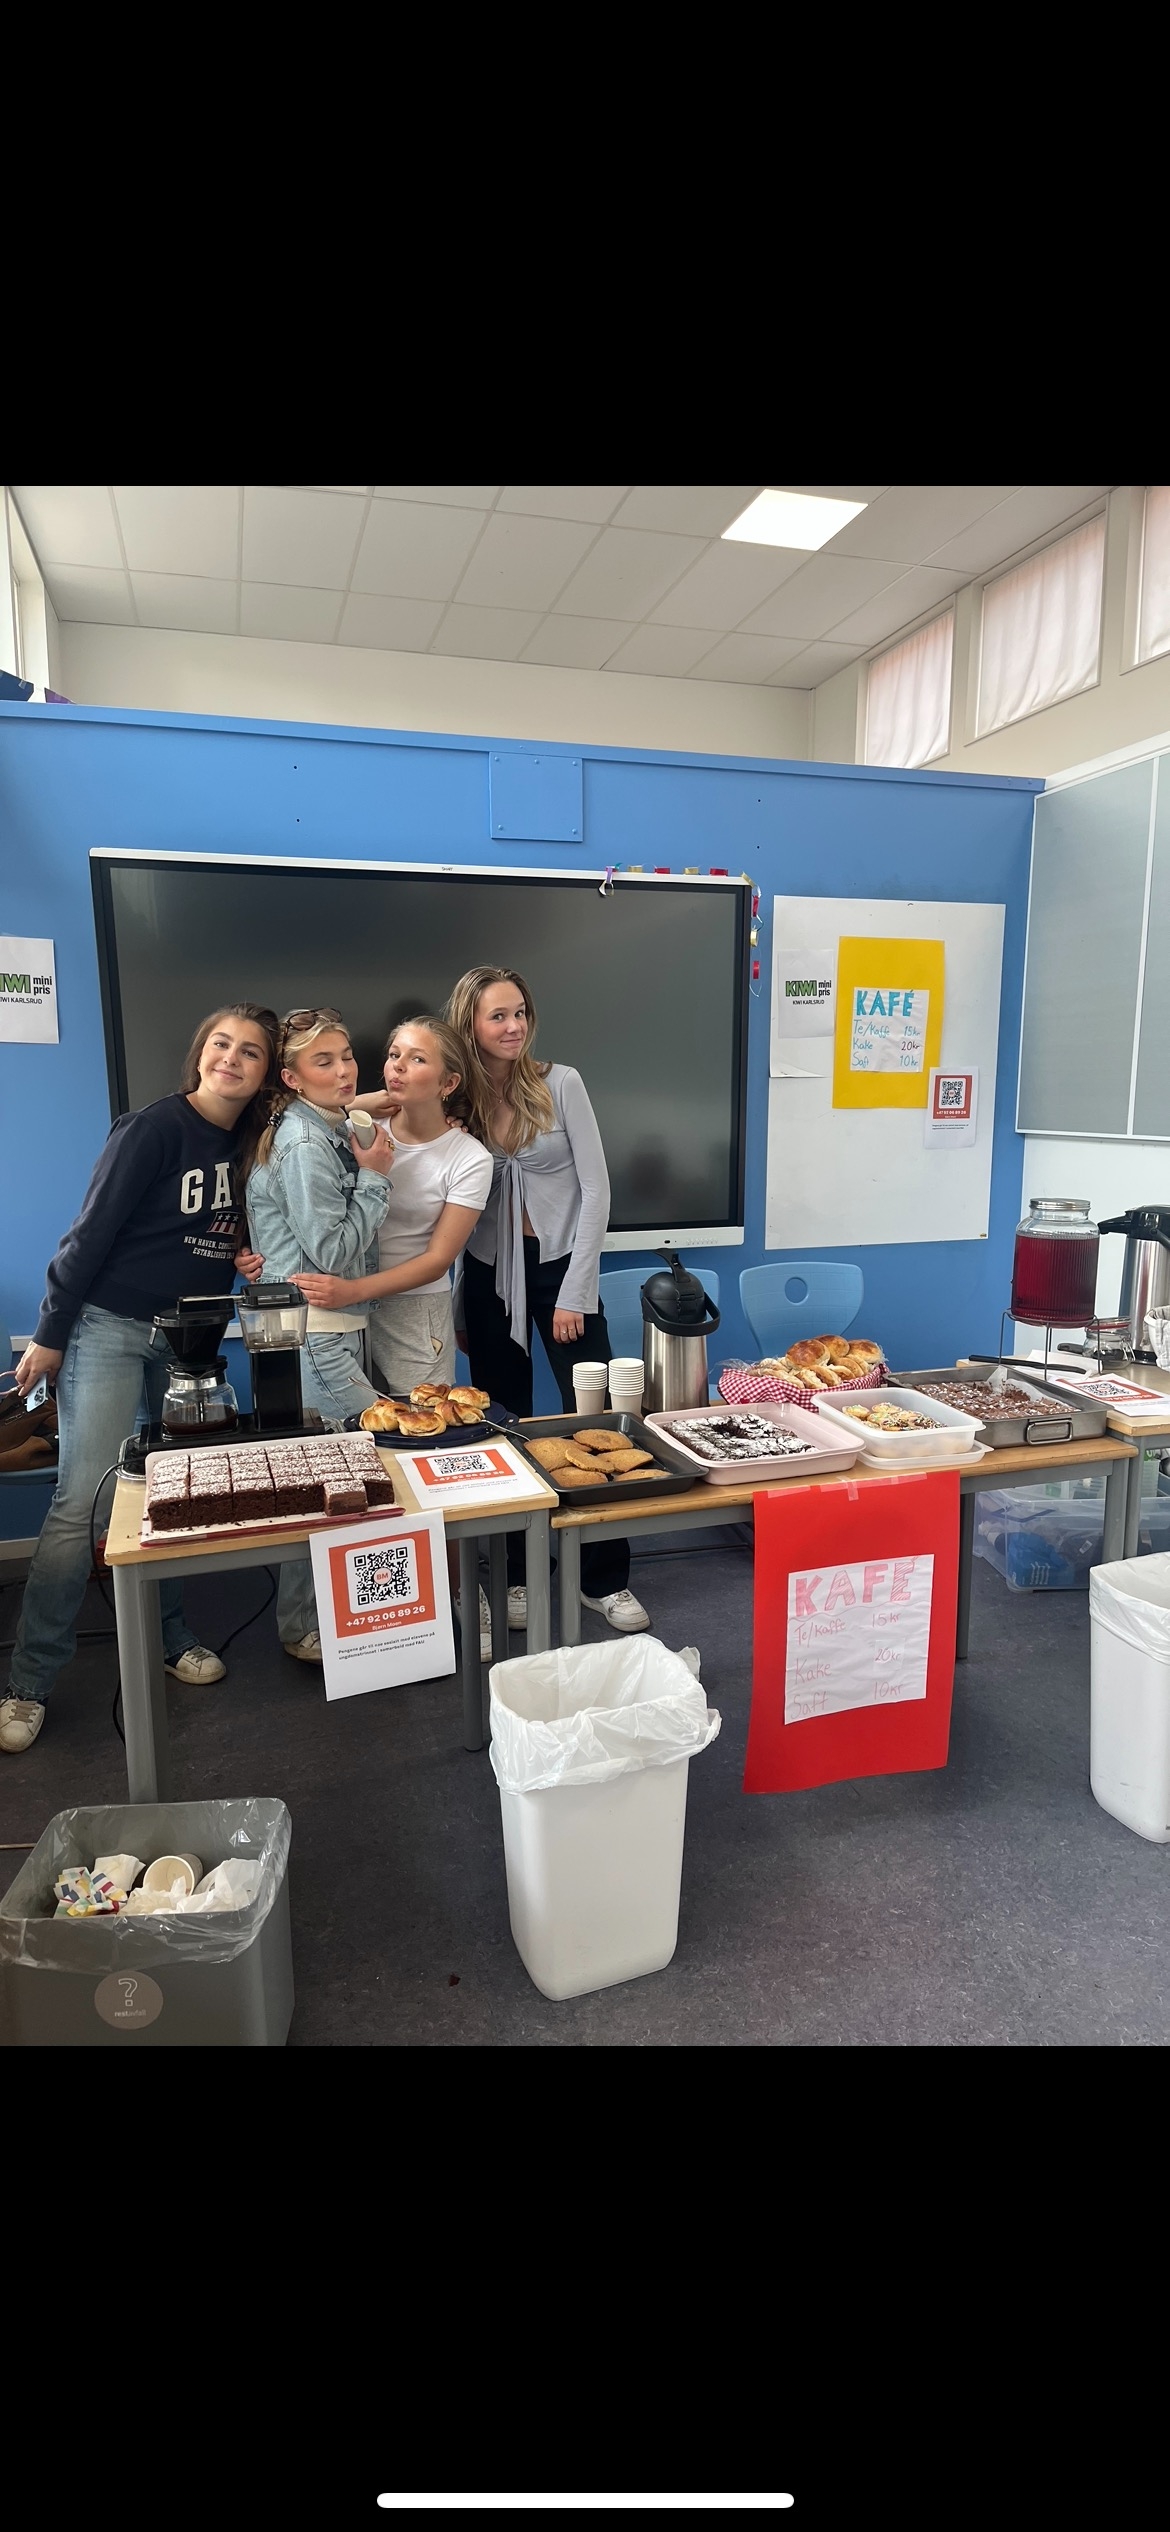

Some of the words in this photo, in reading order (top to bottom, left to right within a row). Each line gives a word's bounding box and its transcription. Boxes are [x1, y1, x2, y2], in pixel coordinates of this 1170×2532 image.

[33, 976, 52, 985] mini
[786, 980, 817, 996] KIWI
[818, 980, 831, 988] mini
[34, 985, 51, 996] pris
[818, 988, 831, 997] pris
[856, 989, 915, 1016] KAFÉ
[853, 1038, 873, 1050] Kake
[852, 1051, 869, 1069] Saft
[180, 1162, 232, 1215] GA
[184, 1236, 197, 1245] NEW
[192, 1247, 226, 1259] ESTABLISHED
[795, 1556, 919, 1617] KAFÉ
[346, 1618, 365, 1627] +47
[367, 1614, 380, 1623] 92
[382, 1612, 396, 1620] 06
[398, 1608, 410, 1617] 89
[413, 1605, 426, 1614] 26
[794, 1658, 831, 1685] Kake
[791, 1691, 828, 1720] Saft
